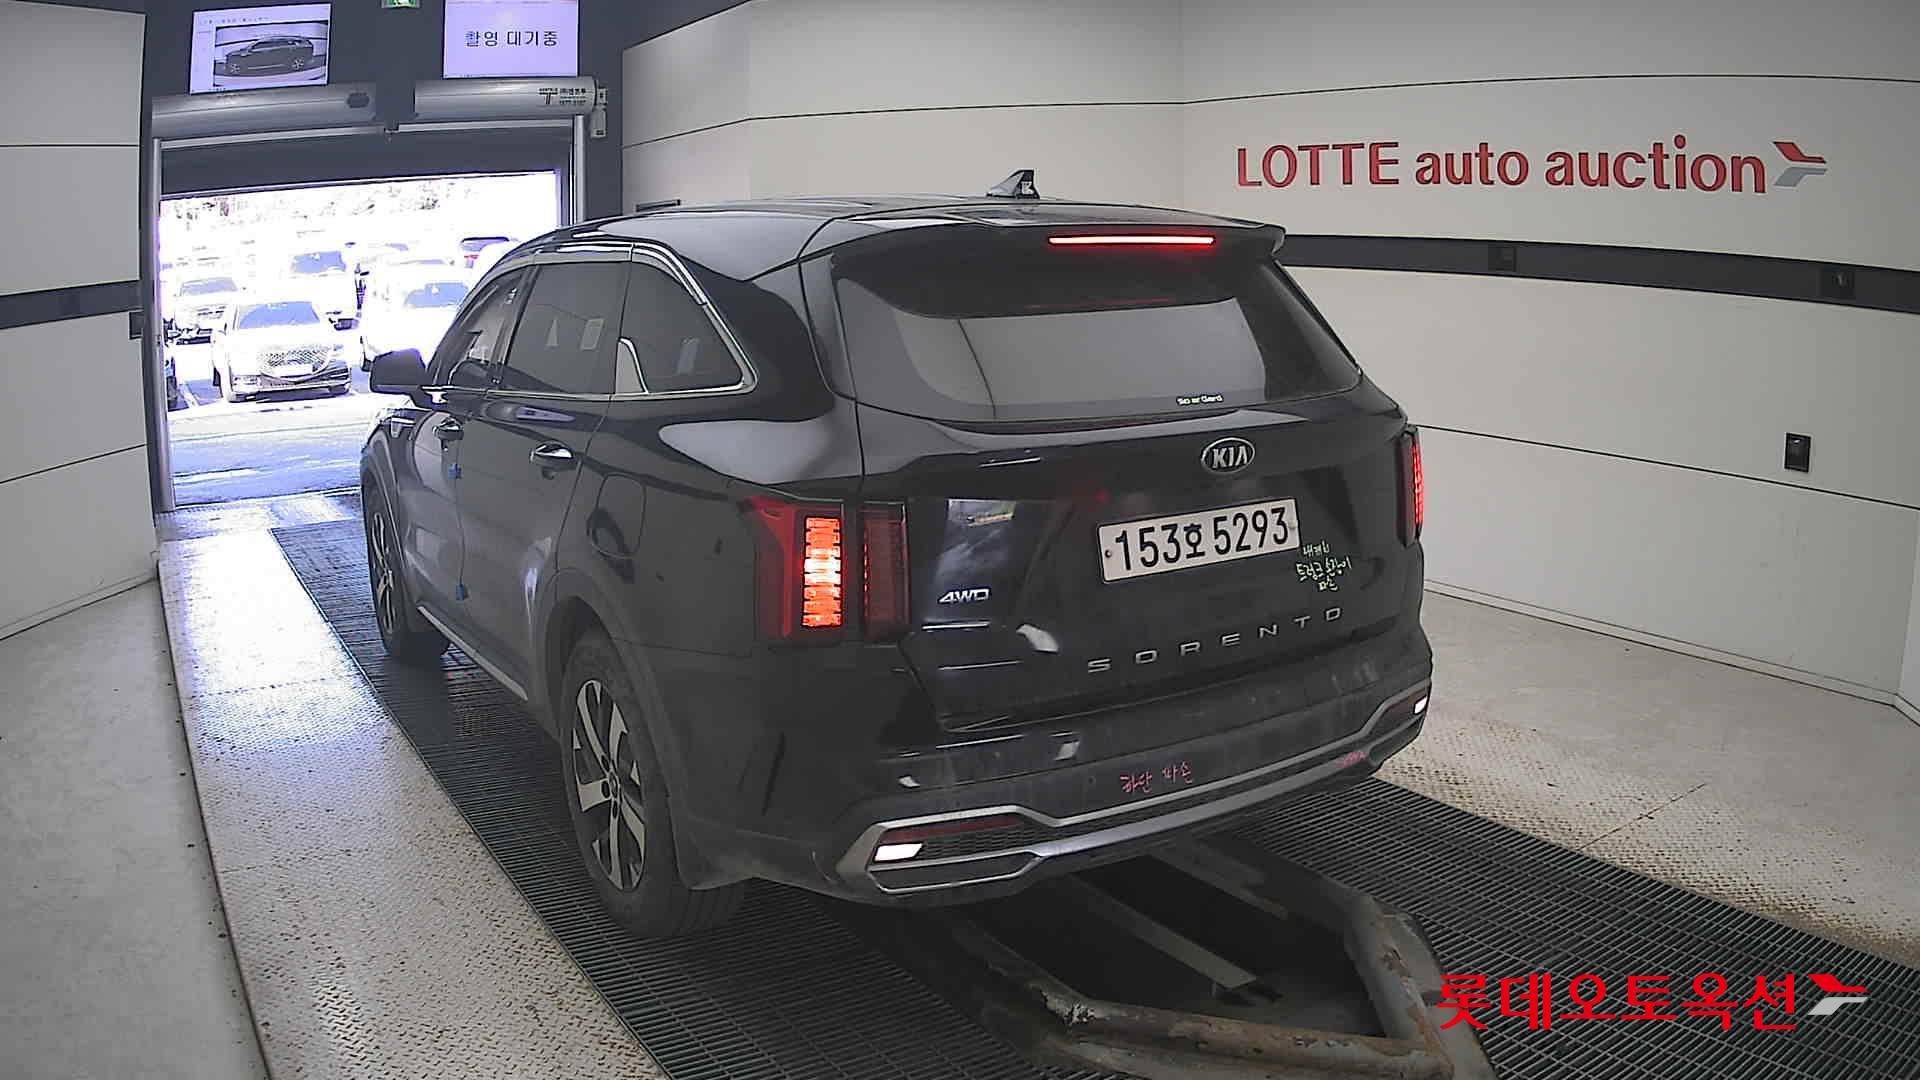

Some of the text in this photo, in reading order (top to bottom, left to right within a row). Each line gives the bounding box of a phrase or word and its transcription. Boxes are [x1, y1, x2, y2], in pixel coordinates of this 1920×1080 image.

[506, 30, 560, 48] 대기중
[1236, 134, 1767, 194] LOTTE auto auction
[1211, 446, 1249, 469] KIA
[1114, 506, 1290, 571] 153호 5293
[938, 588, 990, 604] 4WD
[1087, 607, 1342, 674] SORENTO
